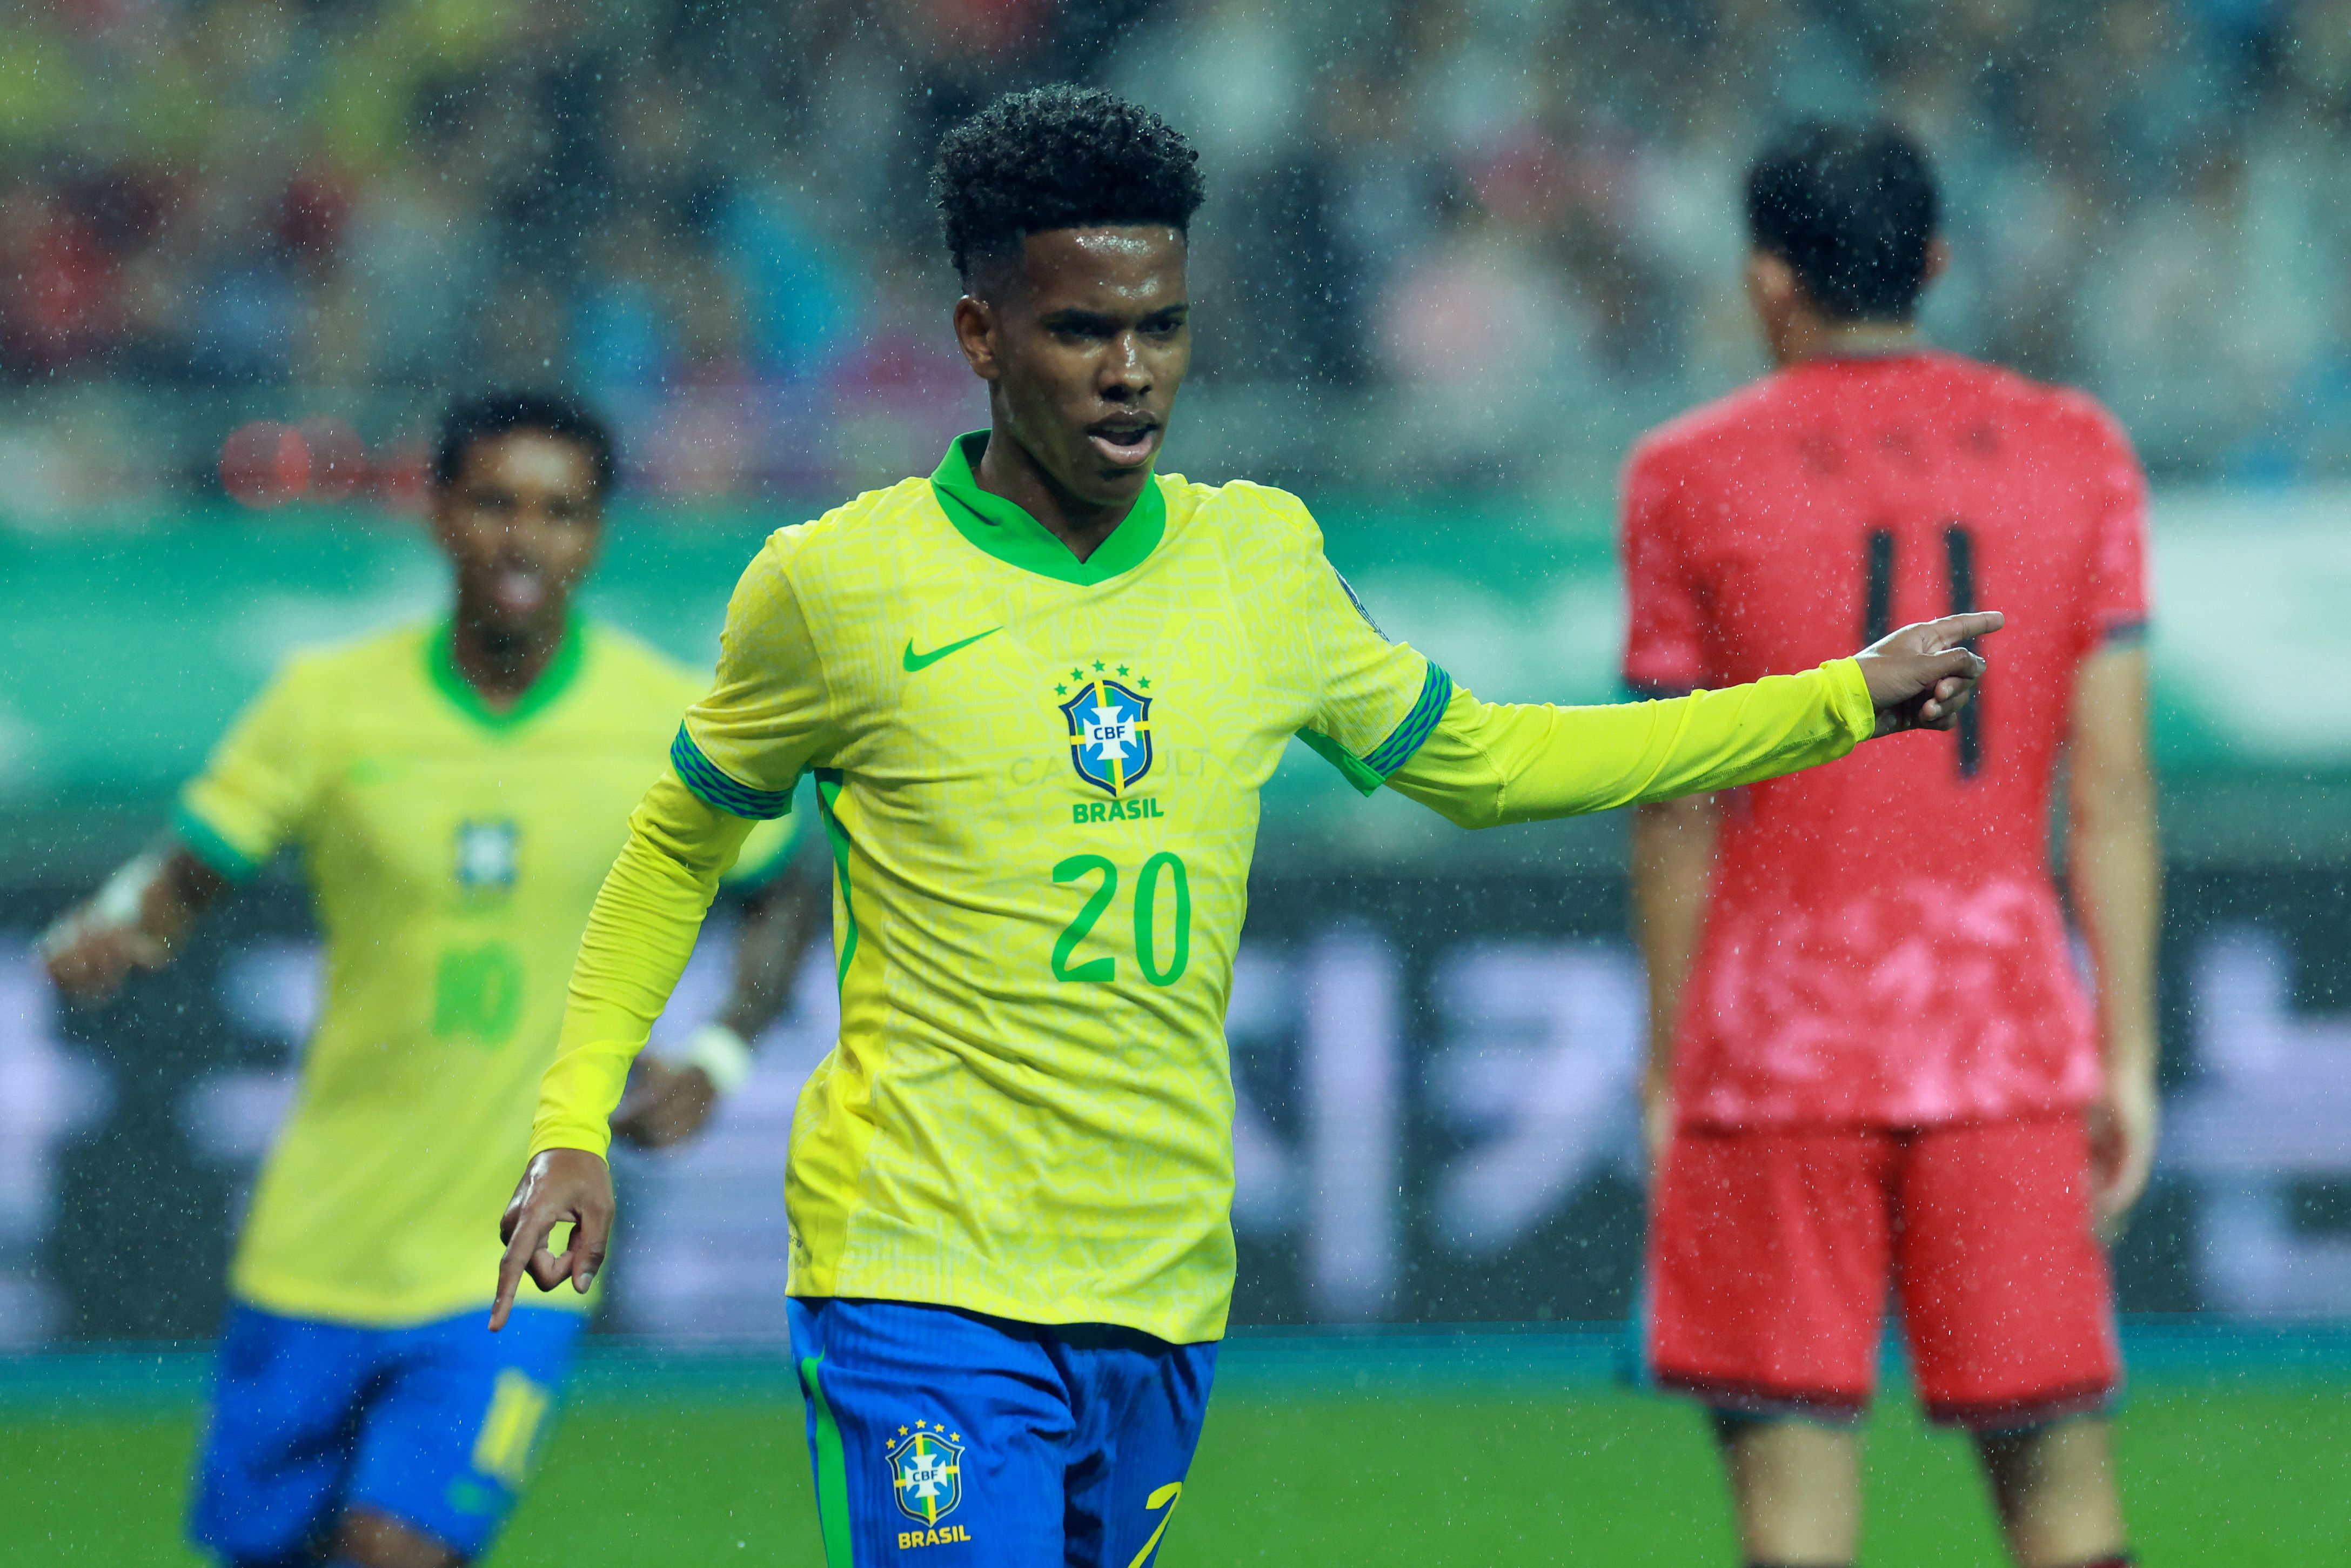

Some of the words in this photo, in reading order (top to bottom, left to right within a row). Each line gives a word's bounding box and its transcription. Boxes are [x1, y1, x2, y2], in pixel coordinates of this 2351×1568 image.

[1093, 725, 1126, 741] CBF
[1073, 798, 1164, 824] BRASIL
[1051, 852, 1190, 987] 20
[912, 1469, 938, 1482] CBF
[897, 1524, 972, 1550] BRASIL
